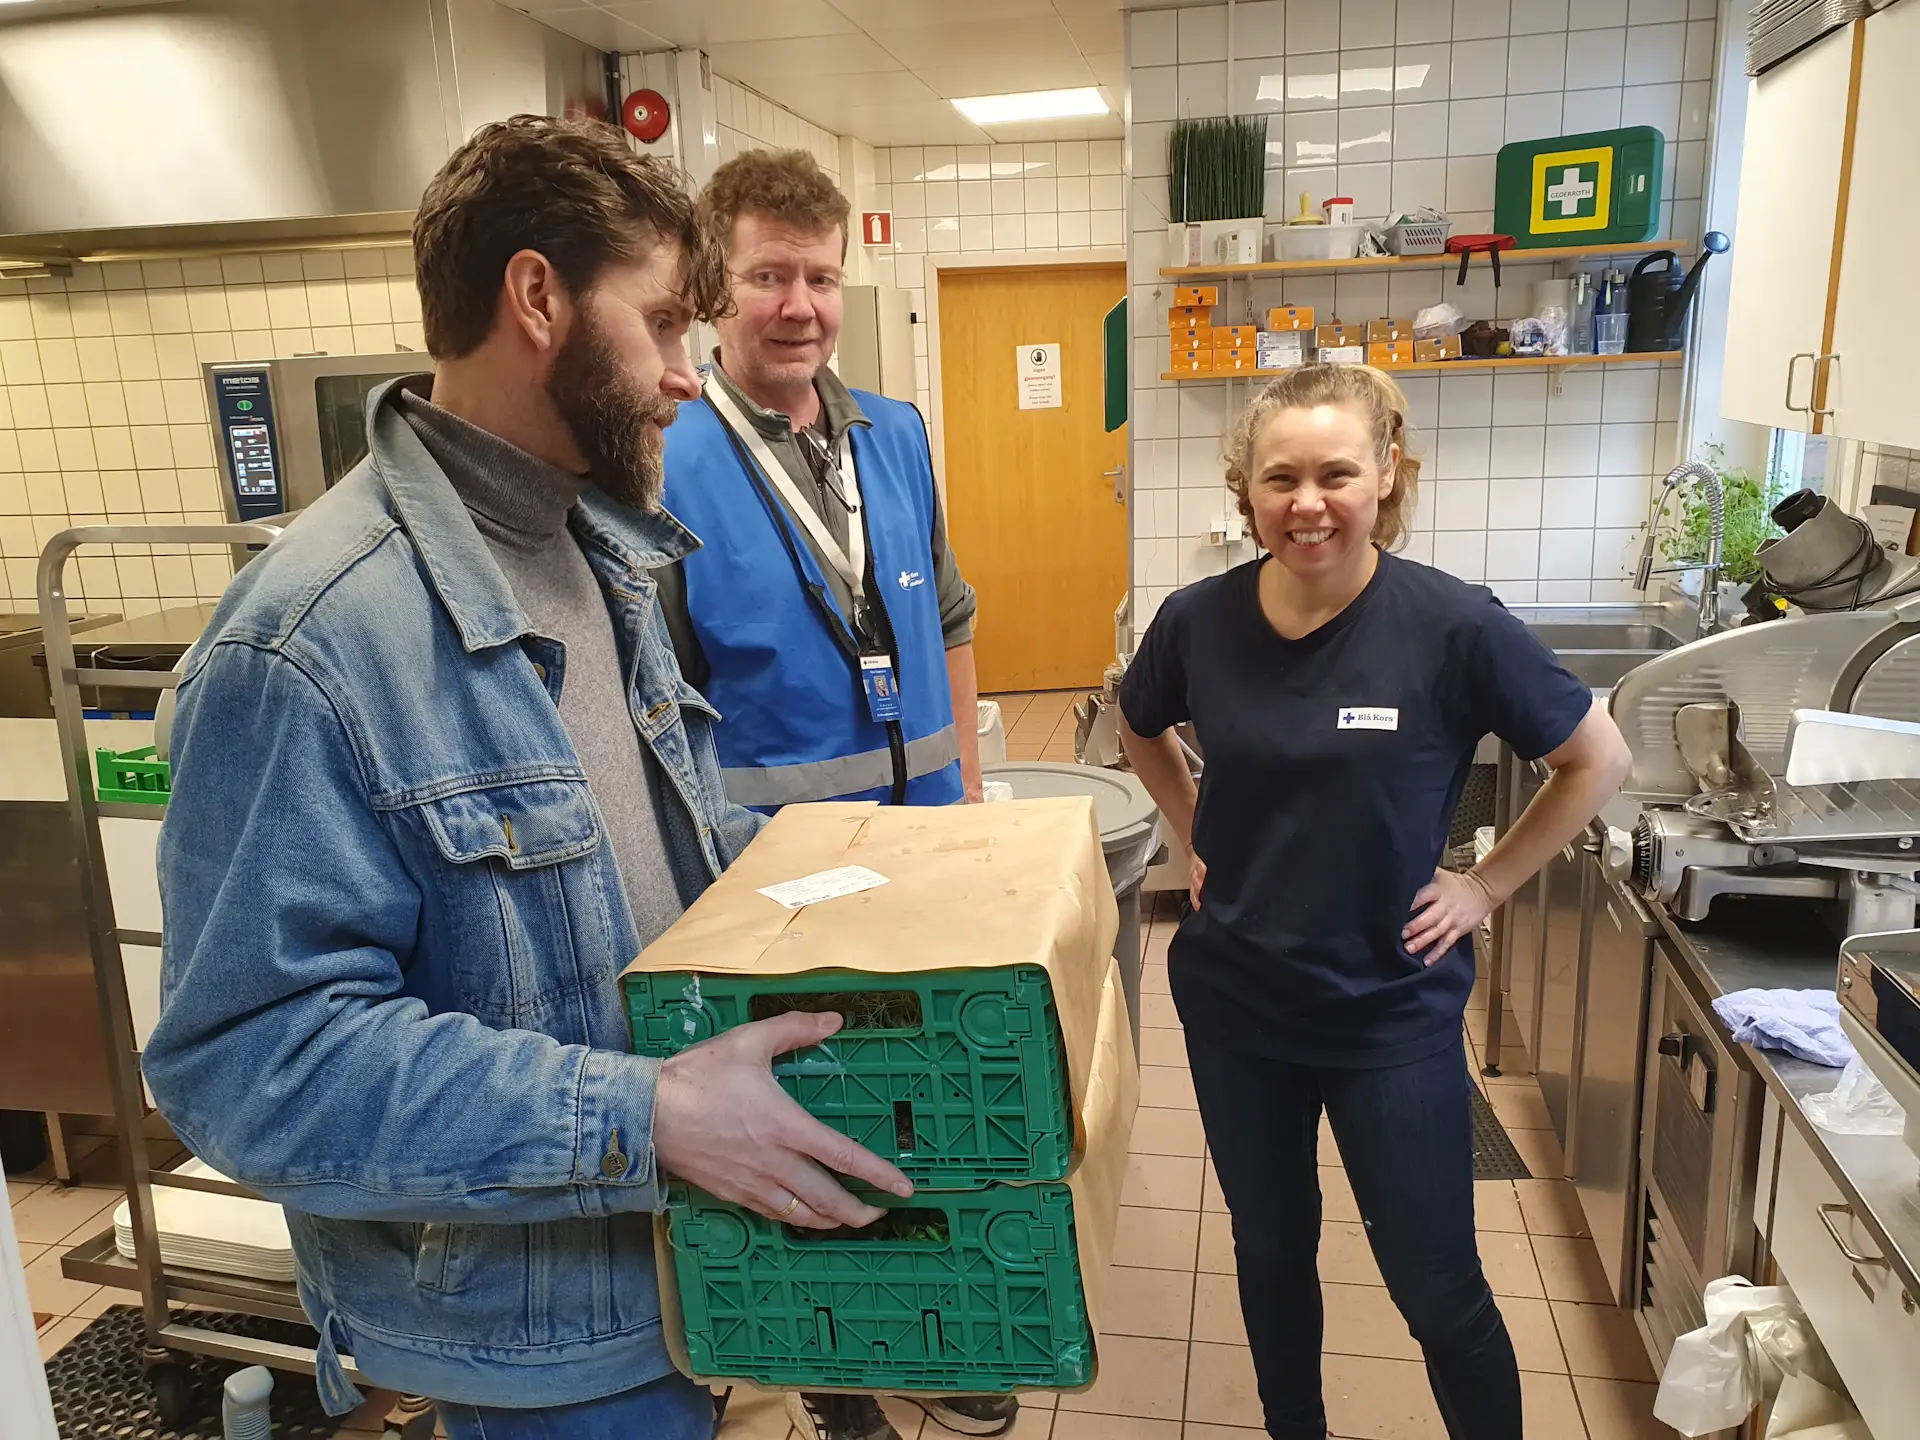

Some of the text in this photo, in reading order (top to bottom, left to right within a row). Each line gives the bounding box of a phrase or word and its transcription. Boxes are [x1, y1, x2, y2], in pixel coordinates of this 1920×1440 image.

[1550, 189, 1591, 199] CEDERROTH
[222, 376, 260, 385] metos
[1357, 711, 1394, 722] Blå Kors
